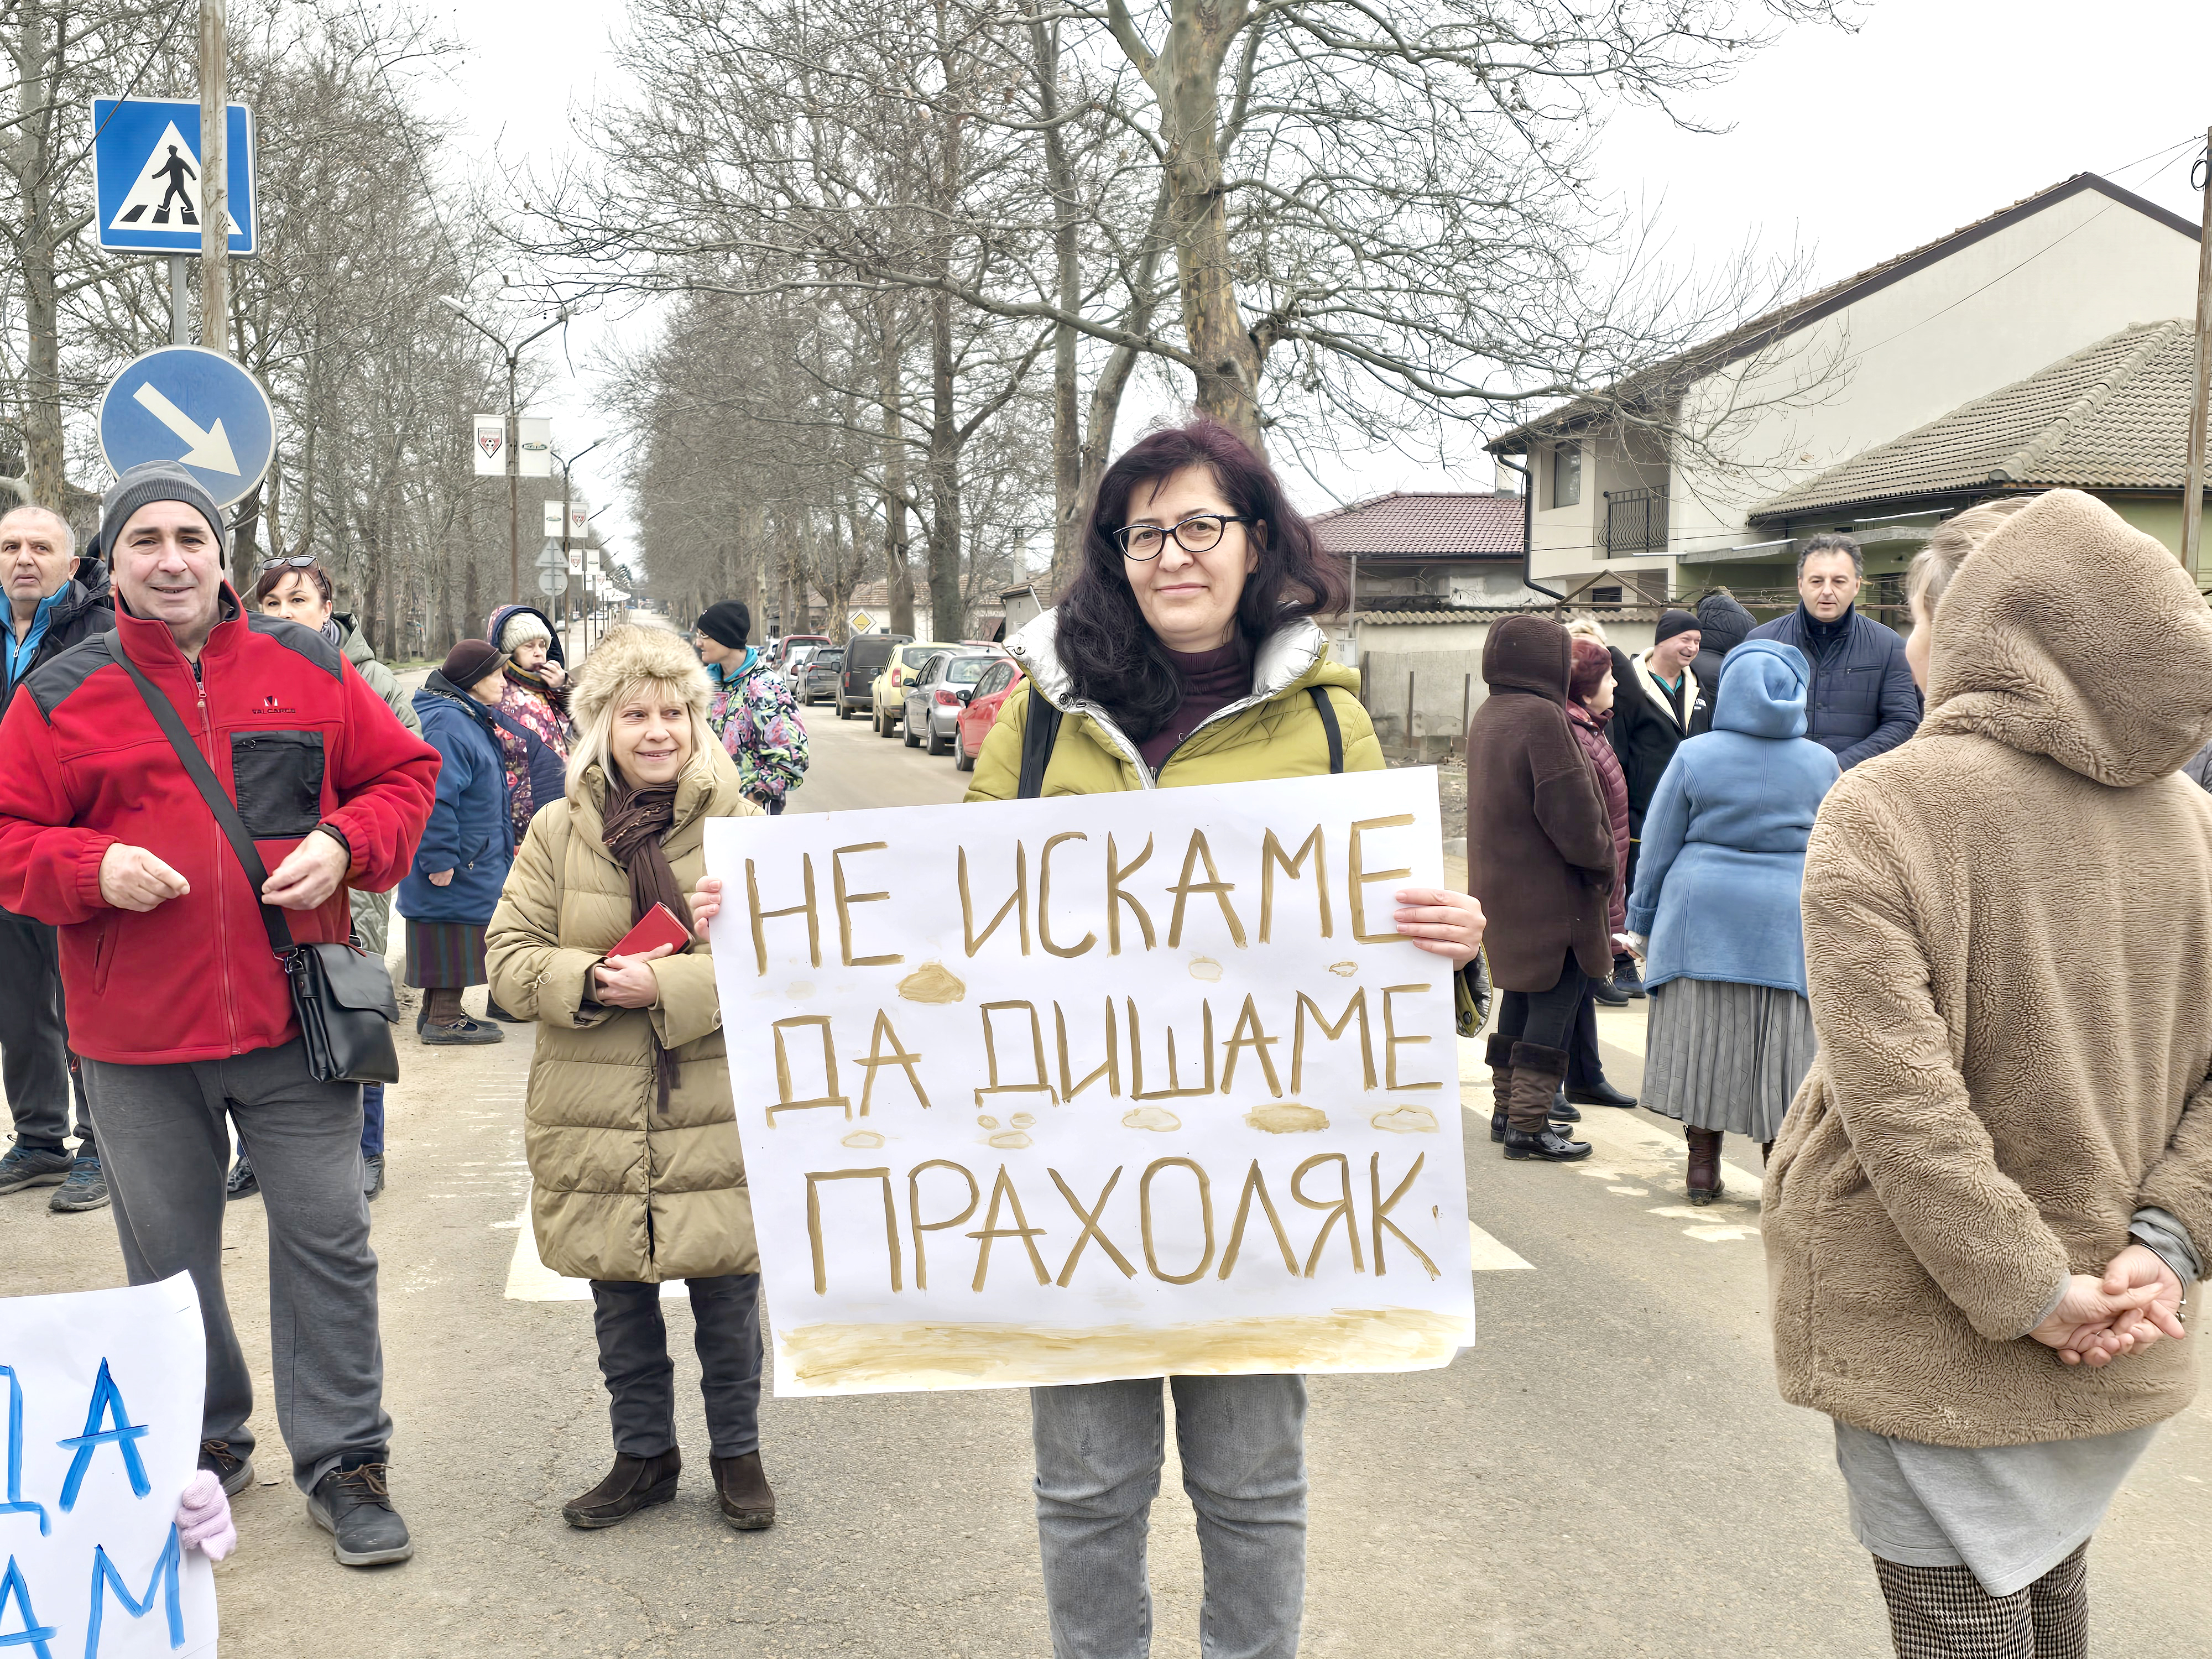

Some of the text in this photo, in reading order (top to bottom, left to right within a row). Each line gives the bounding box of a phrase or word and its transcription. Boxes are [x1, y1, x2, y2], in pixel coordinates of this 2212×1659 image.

[745, 813, 1416, 977] НЕ ИСКАМЕ
[765, 983, 1444, 1129] ДА ДИШАМЕ
[804, 1151, 1442, 1296] ПРАХОЛЯК
